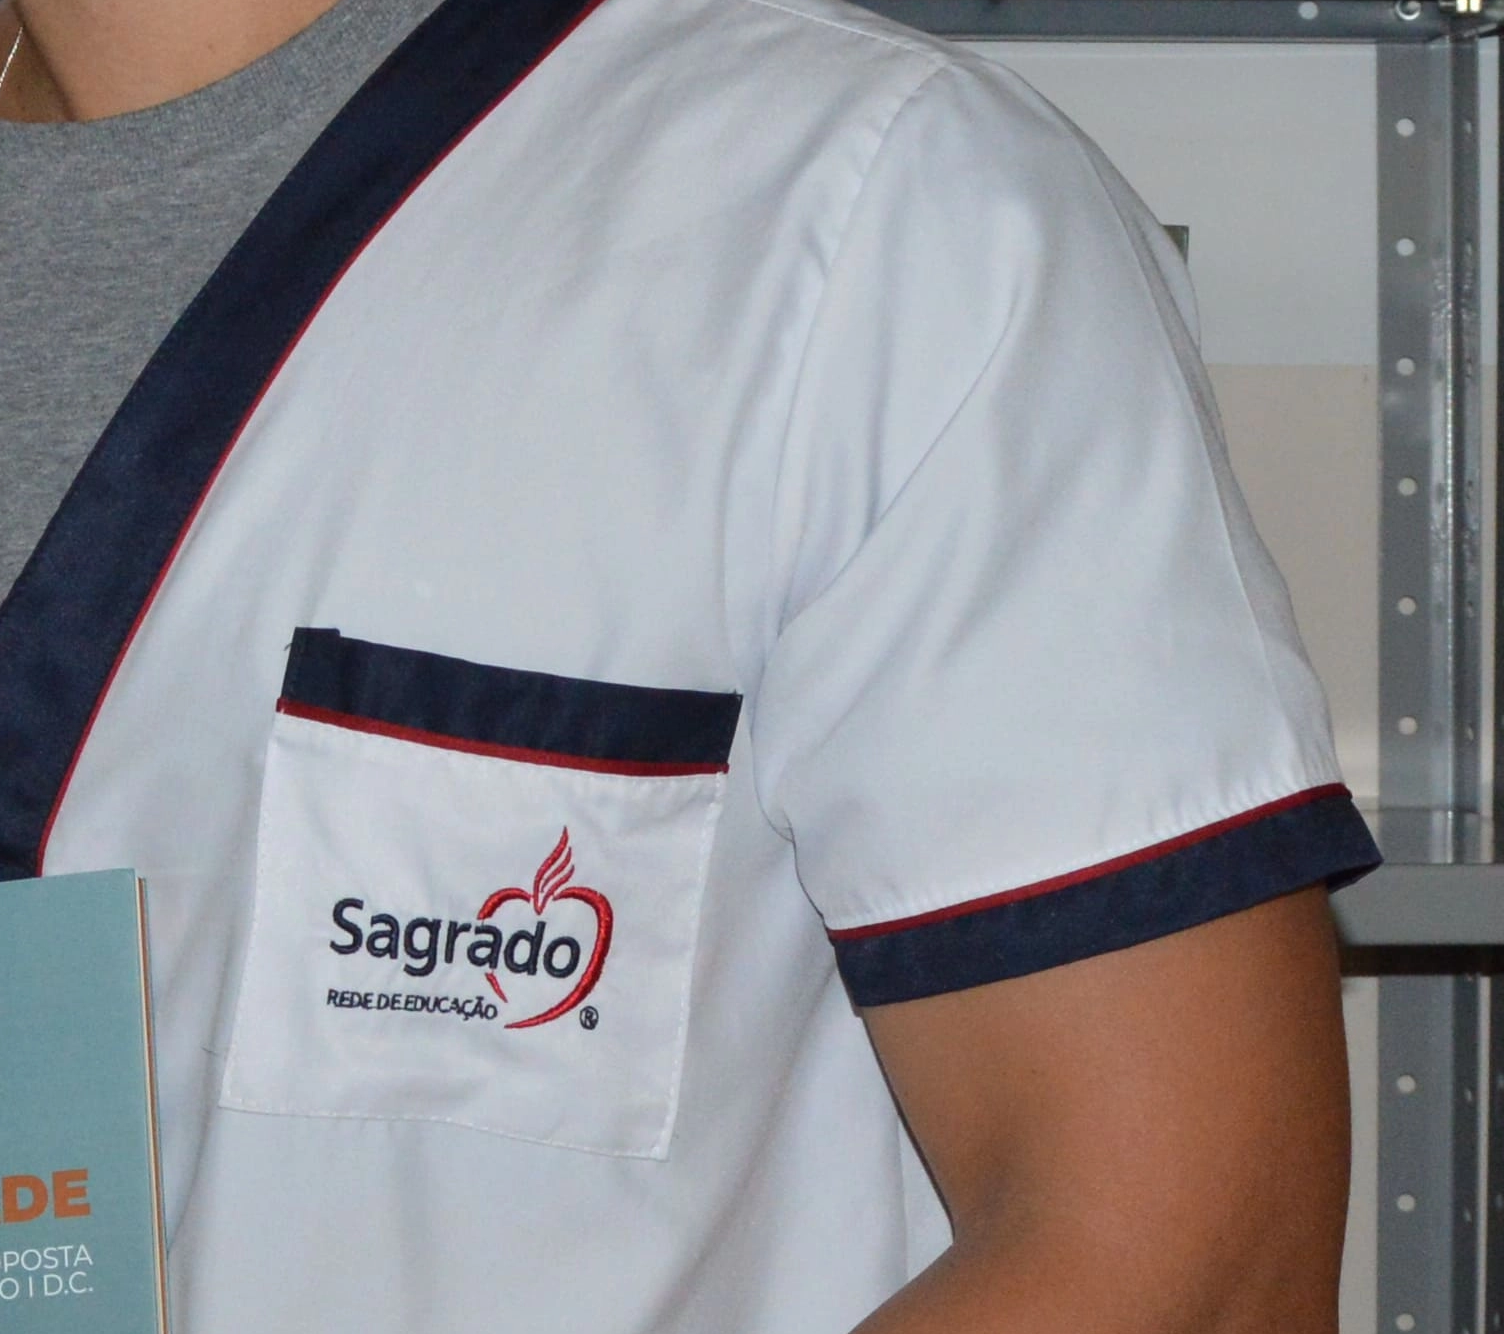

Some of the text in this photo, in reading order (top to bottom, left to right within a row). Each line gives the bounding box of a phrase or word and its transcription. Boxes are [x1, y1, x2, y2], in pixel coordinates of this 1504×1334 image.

[329, 897, 581, 978] Sagrado
[327, 989, 498, 1021] REDE DE EDUCAÇÃO
[29, 1276, 34, 1298] I
[44, 1272, 94, 1297] D.C.
